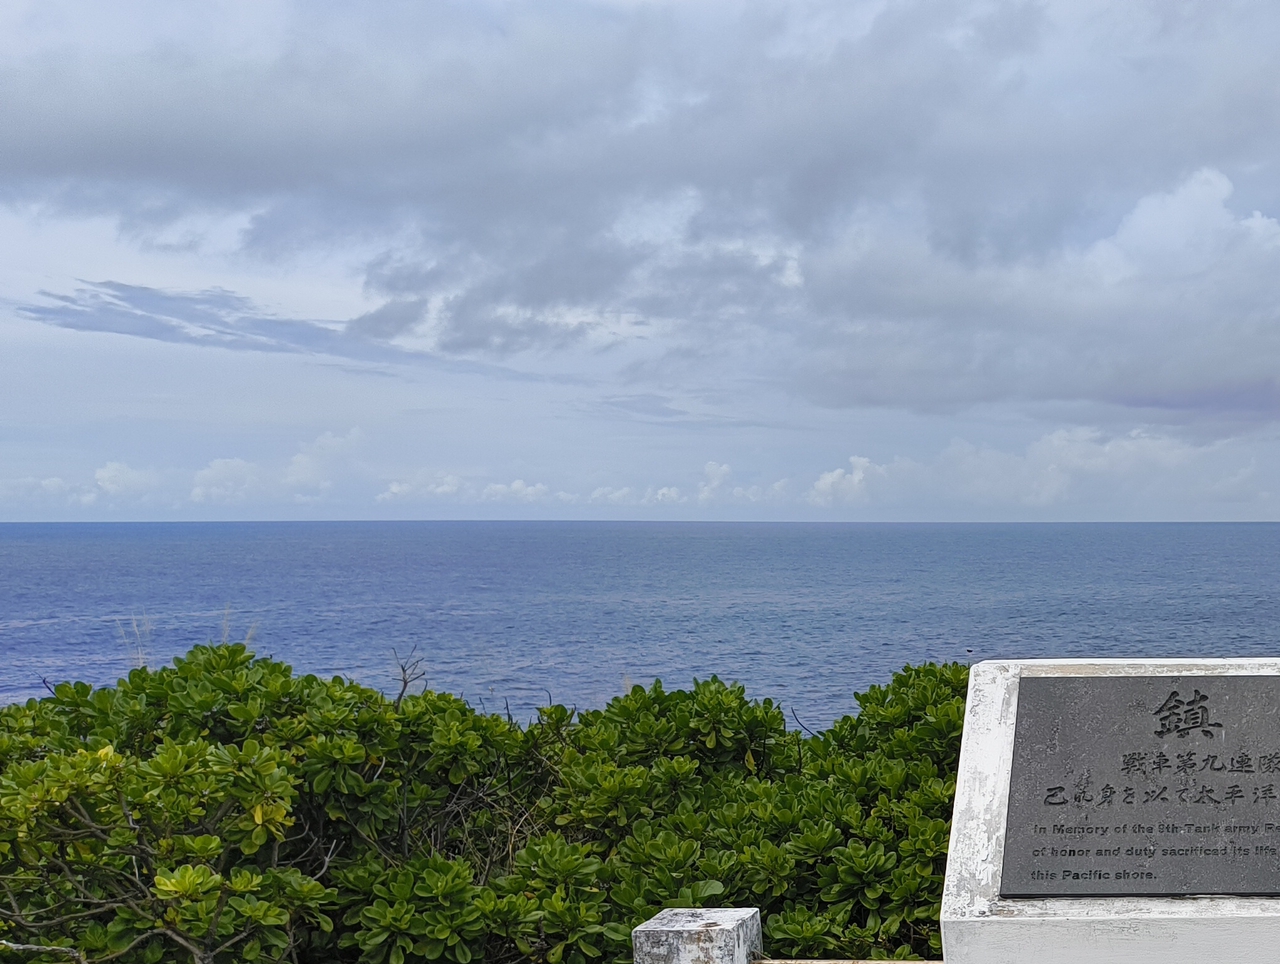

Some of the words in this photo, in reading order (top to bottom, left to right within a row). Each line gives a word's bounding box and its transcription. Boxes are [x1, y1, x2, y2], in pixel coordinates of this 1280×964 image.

[1052, 824, 1109, 836] Memory
[1114, 824, 1128, 834] of
[1132, 823, 1154, 834] the
[1184, 823, 1220, 834] Tank
[1224, 824, 1258, 835] army
[1032, 847, 1046, 857] of
[1051, 847, 1091, 857] honor
[1095, 847, 1120, 857] and
[1125, 846, 1156, 858] duty
[1161, 845, 1228, 856] sacrificed
[1232, 845, 1250, 856] its
[1254, 845, 1276, 856] life
[1031, 870, 1057, 880] this
[1062, 869, 1110, 880] Pacific
[1114, 869, 1157, 880] shore.
